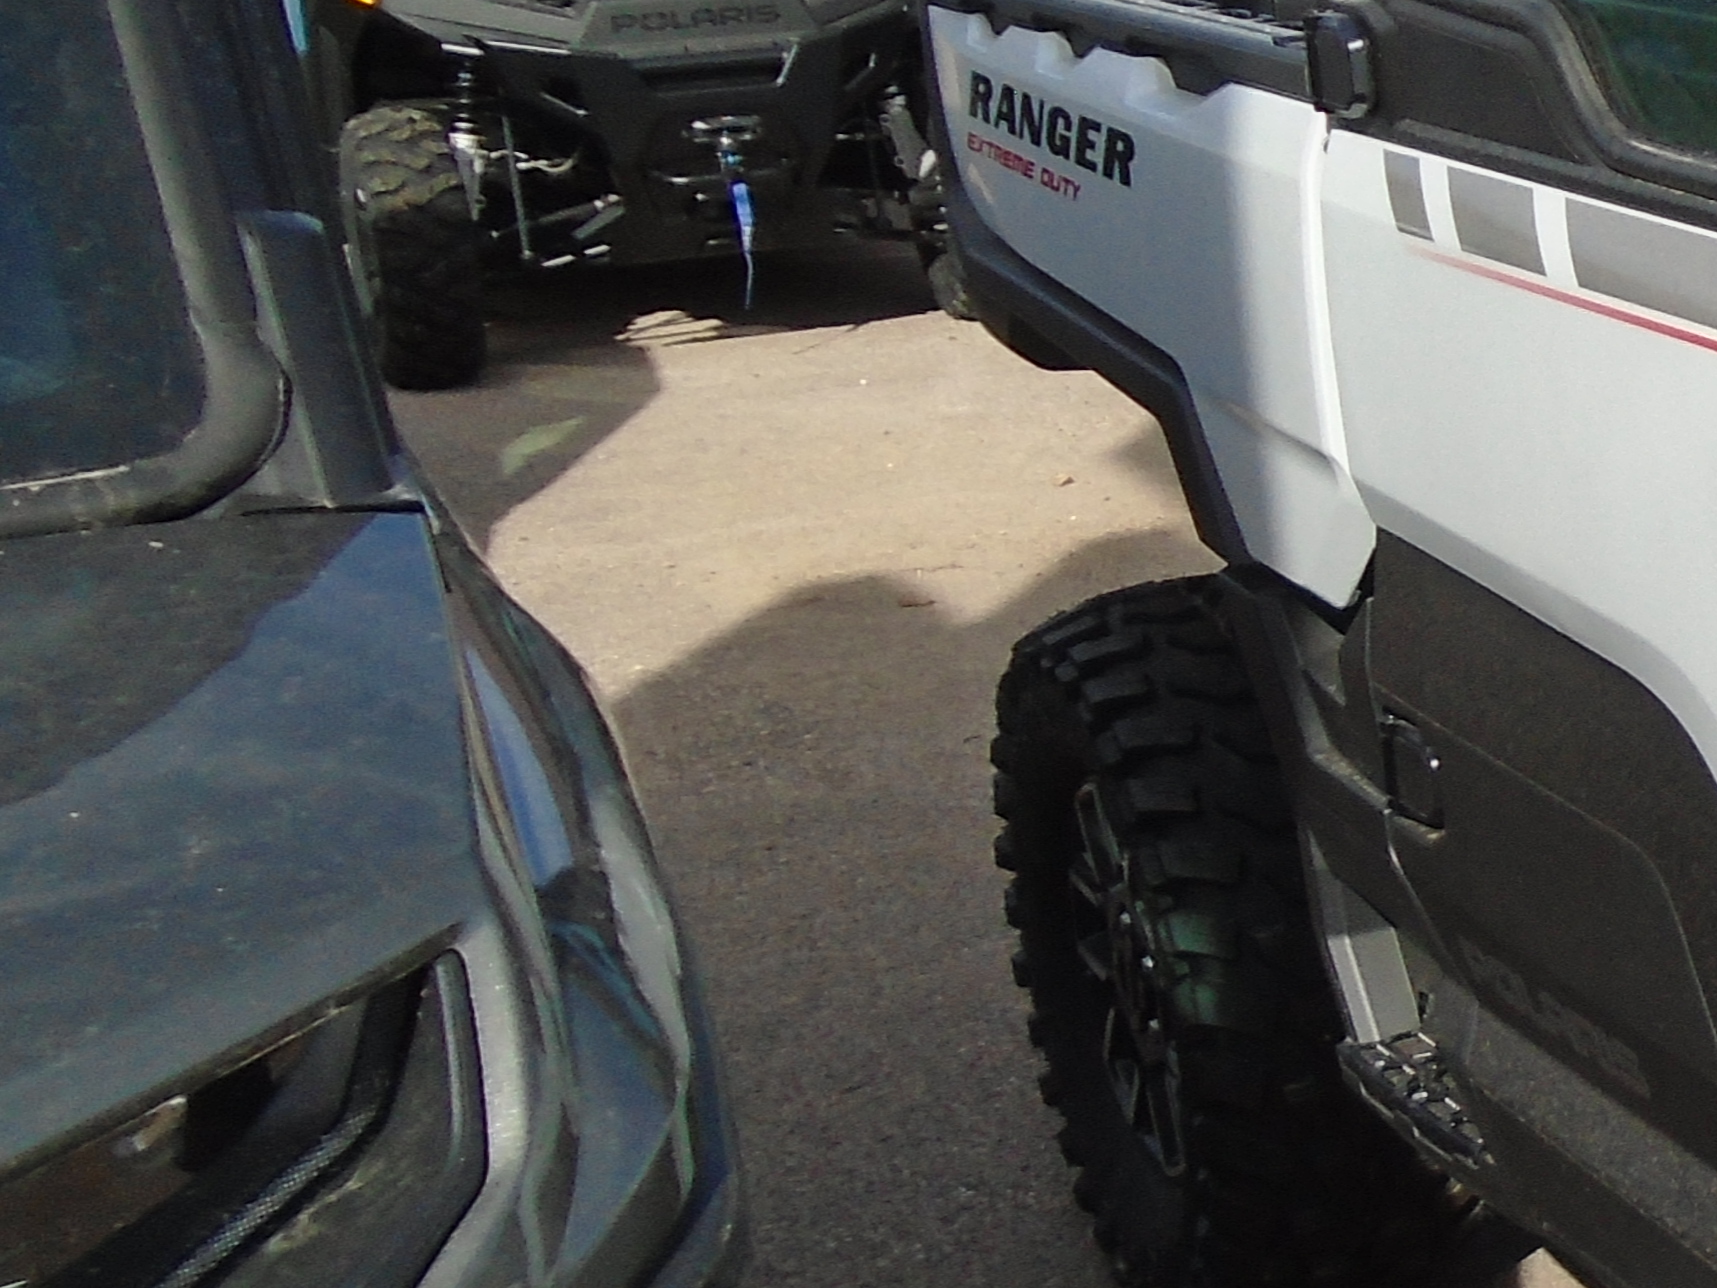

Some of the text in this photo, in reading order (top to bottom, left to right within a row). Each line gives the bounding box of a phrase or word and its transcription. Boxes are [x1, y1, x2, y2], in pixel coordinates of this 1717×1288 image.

[610, 3, 781, 33] POLARIS
[969, 69, 1136, 188] RANGER
[967, 131, 1081, 201] EXTREME DUTY
